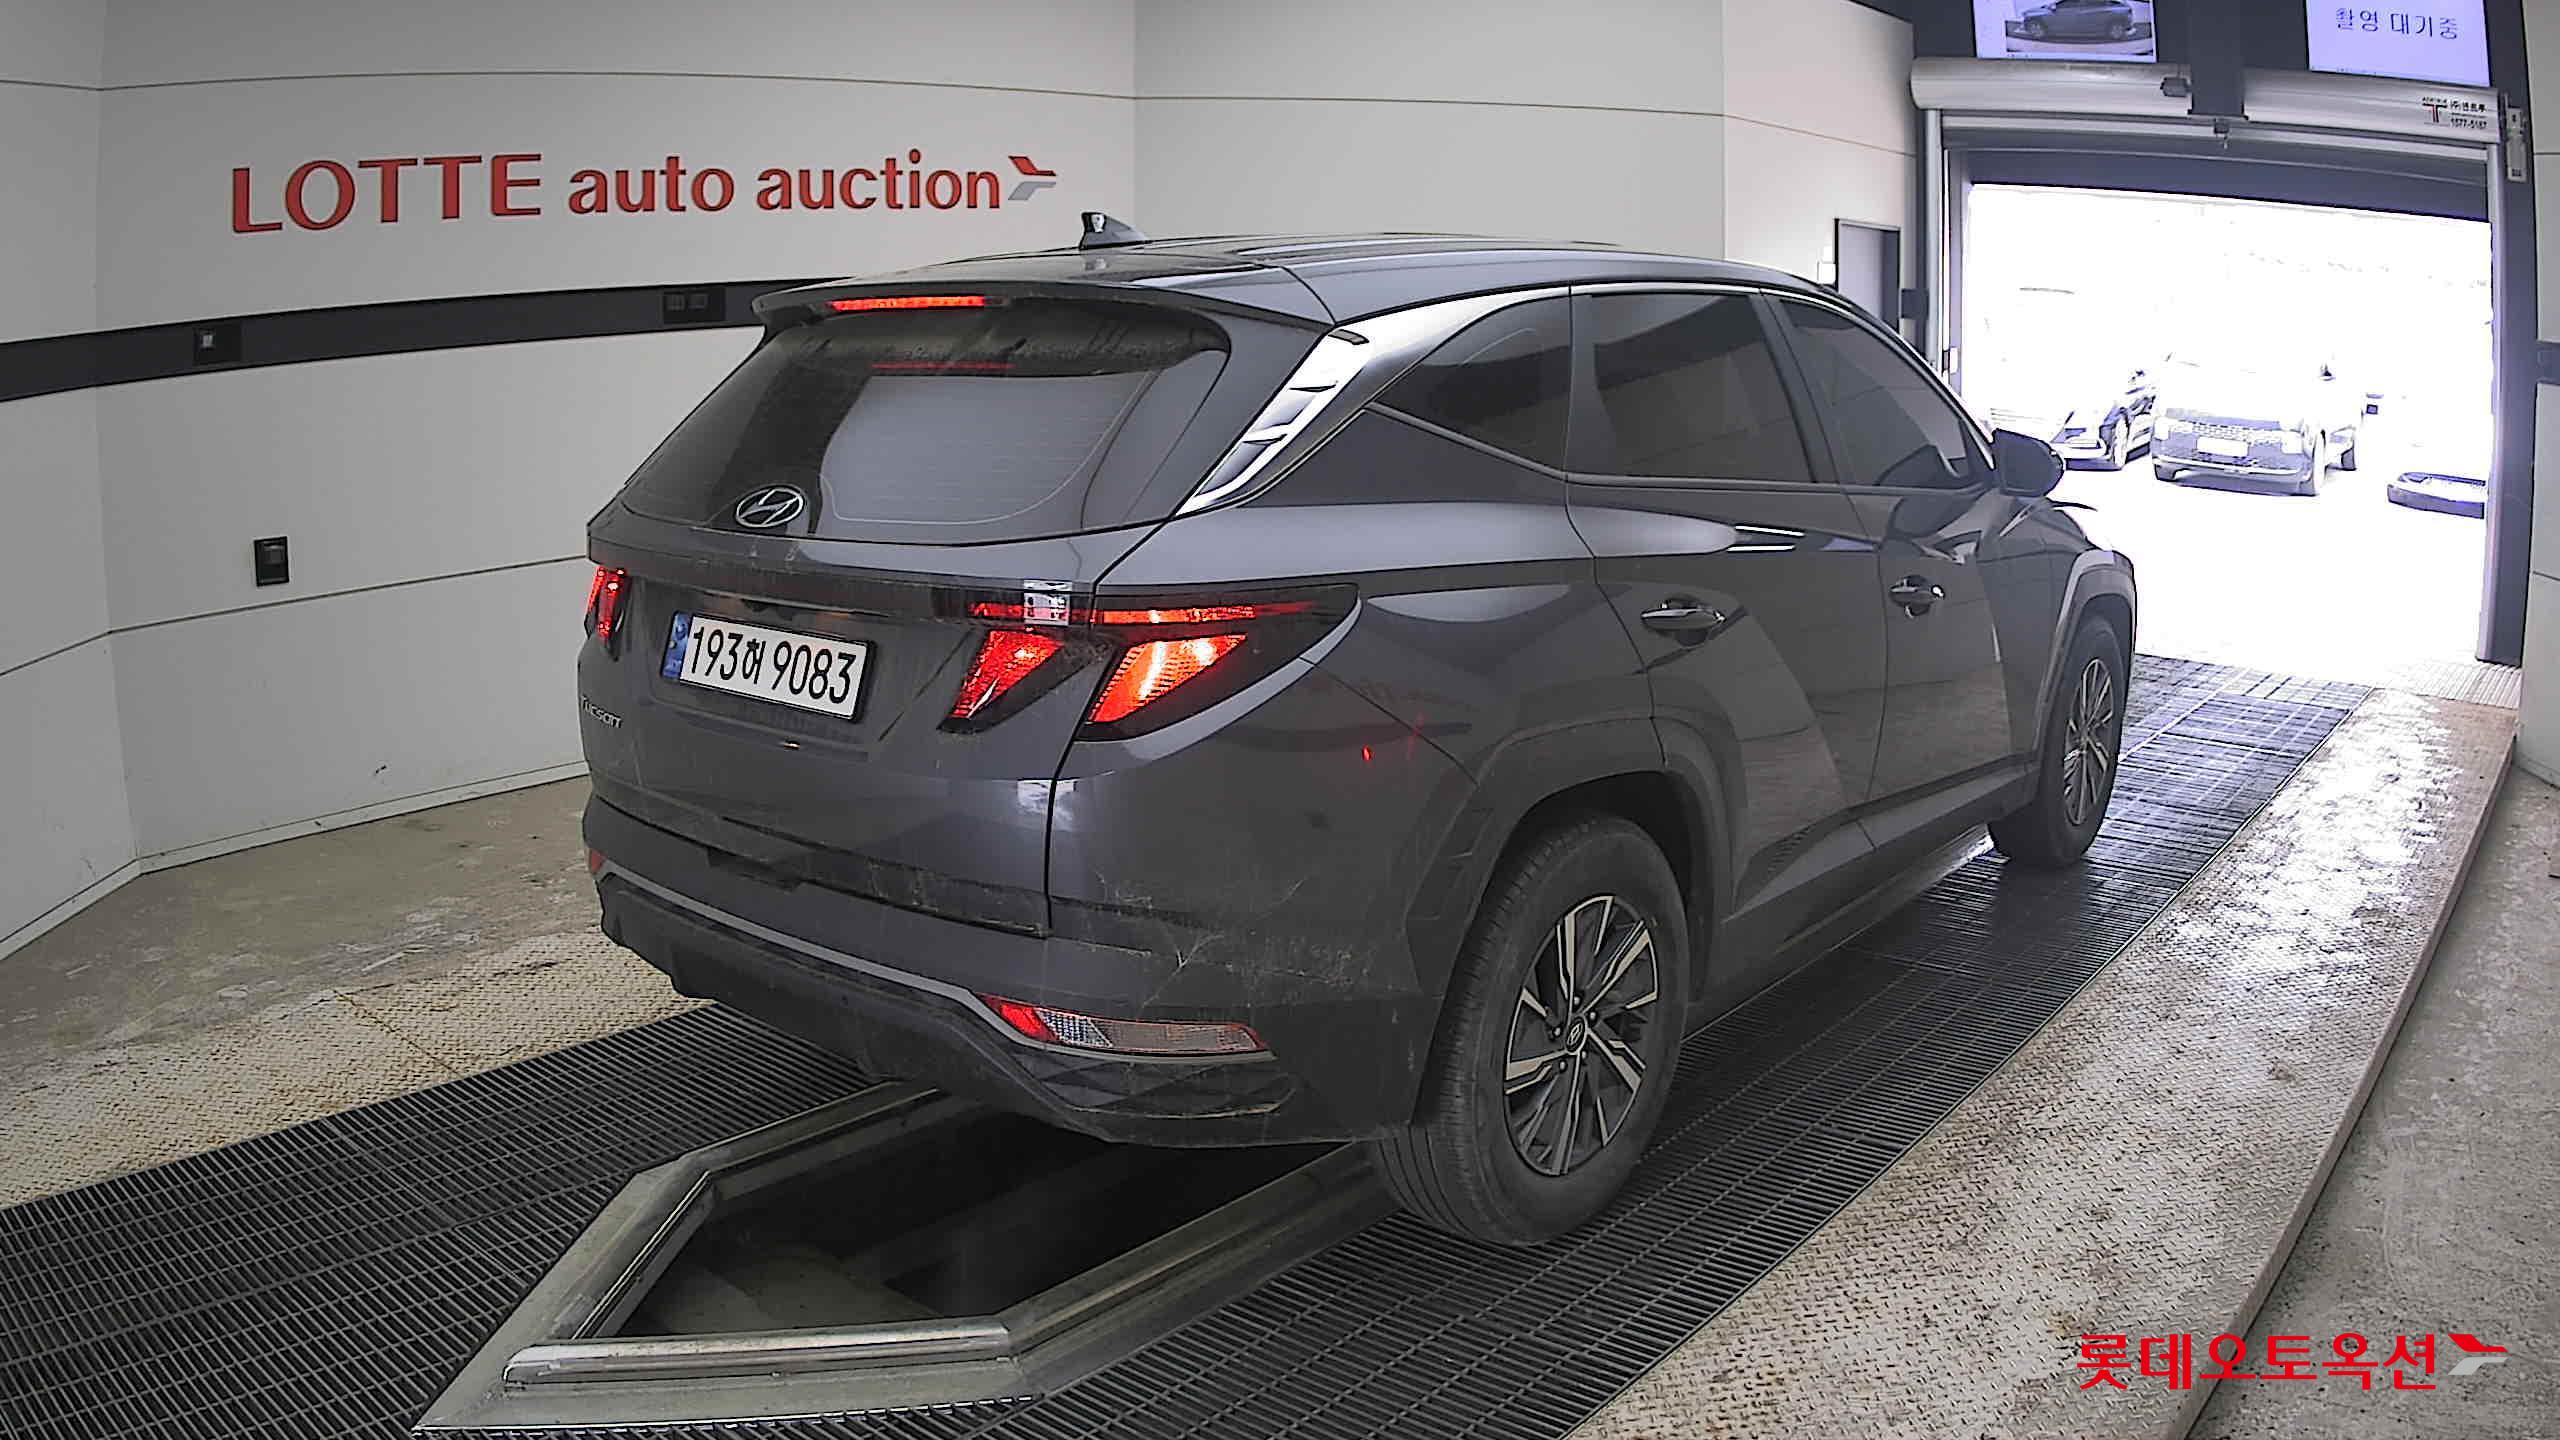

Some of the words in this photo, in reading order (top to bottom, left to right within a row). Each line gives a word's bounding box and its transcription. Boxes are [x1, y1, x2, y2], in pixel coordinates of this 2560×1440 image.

[2336, 8, 2379, 33] 촬영
[2390, 13, 2458, 40] 대기중
[232, 153, 542, 233] LOTTE
[568, 156, 735, 214] auto
[756, 149, 1001, 210] auction
[691, 626, 765, 684] 193허
[770, 641, 857, 704] 9083
